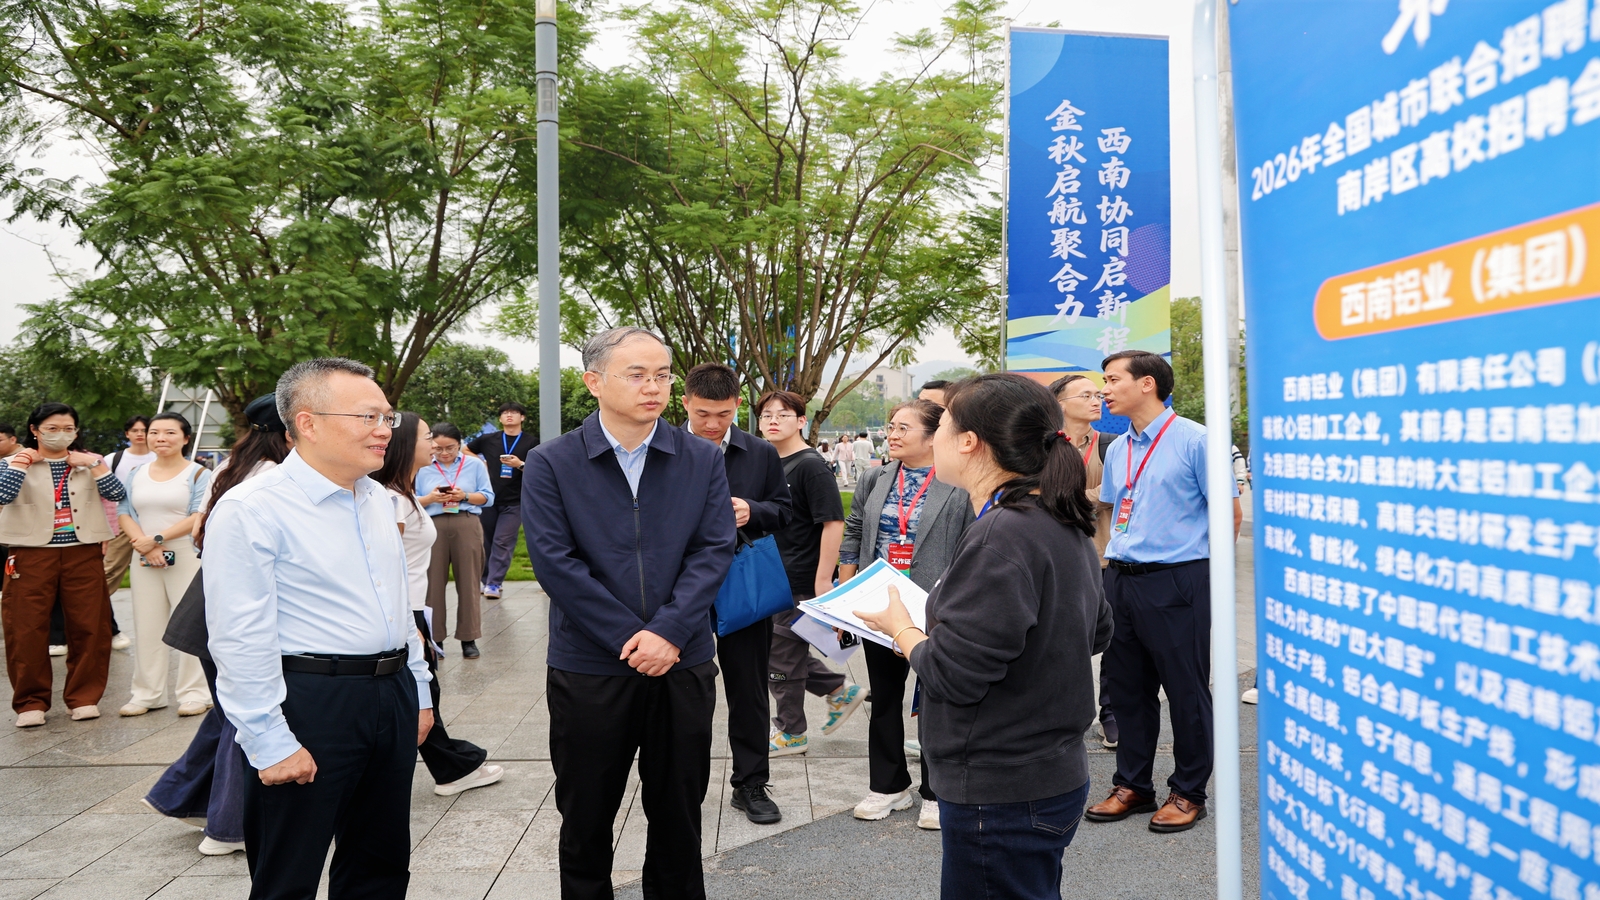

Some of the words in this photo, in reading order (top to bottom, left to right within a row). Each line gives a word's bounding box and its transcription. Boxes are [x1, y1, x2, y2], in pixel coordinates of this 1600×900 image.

[1251, 0, 1600, 201] 2026年全国城市联合招聘
[1337, 57, 1600, 216] 南岸区高校招聘会
[1045, 99, 1088, 327] 金秋启航聚合力
[1090, 126, 1134, 357] 西南协同启新程
[1284, 341, 1600, 402] 西南铝业（集团）有限责任公司（
[1263, 452, 1600, 504] 为我国综合实力最强的特大型铝加工企
[1263, 488, 1600, 561] 程材料研发保障、高精尖铝材研发生产
[891, 557, 912, 565] 工作证
[1264, 525, 1600, 625] 高端化、智能化、绿色化方向高质量发
